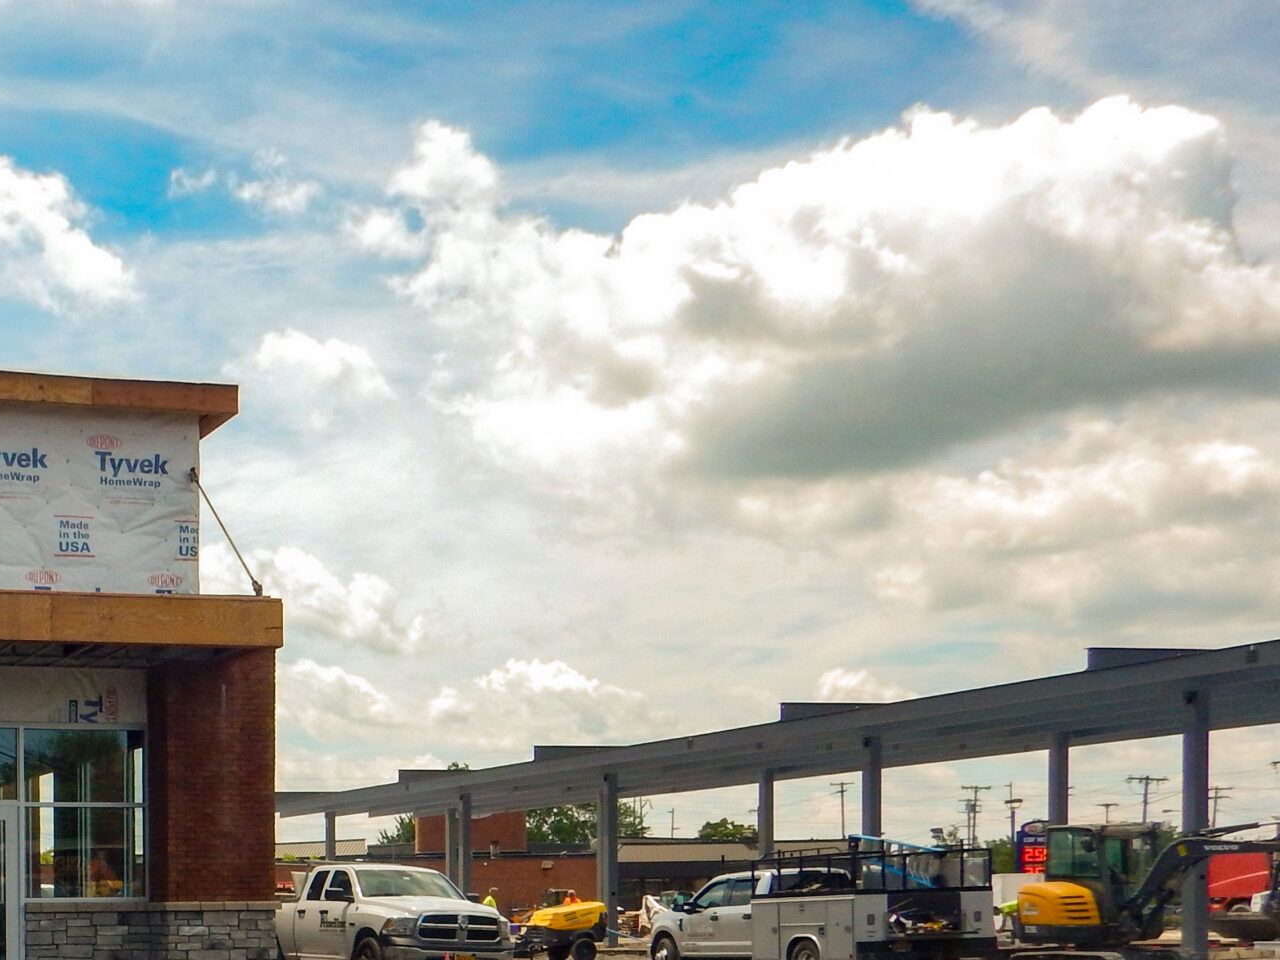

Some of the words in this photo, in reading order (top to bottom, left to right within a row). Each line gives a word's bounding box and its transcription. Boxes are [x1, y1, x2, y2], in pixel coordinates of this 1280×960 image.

[95, 451, 168, 477] Tyvek
[99, 476, 161, 489] HomeWrap
[59, 520, 89, 530] Made
[59, 530, 69, 539] in
[73, 531, 90, 540] the
[179, 535, 189, 543] in
[59, 541, 91, 553] USA
